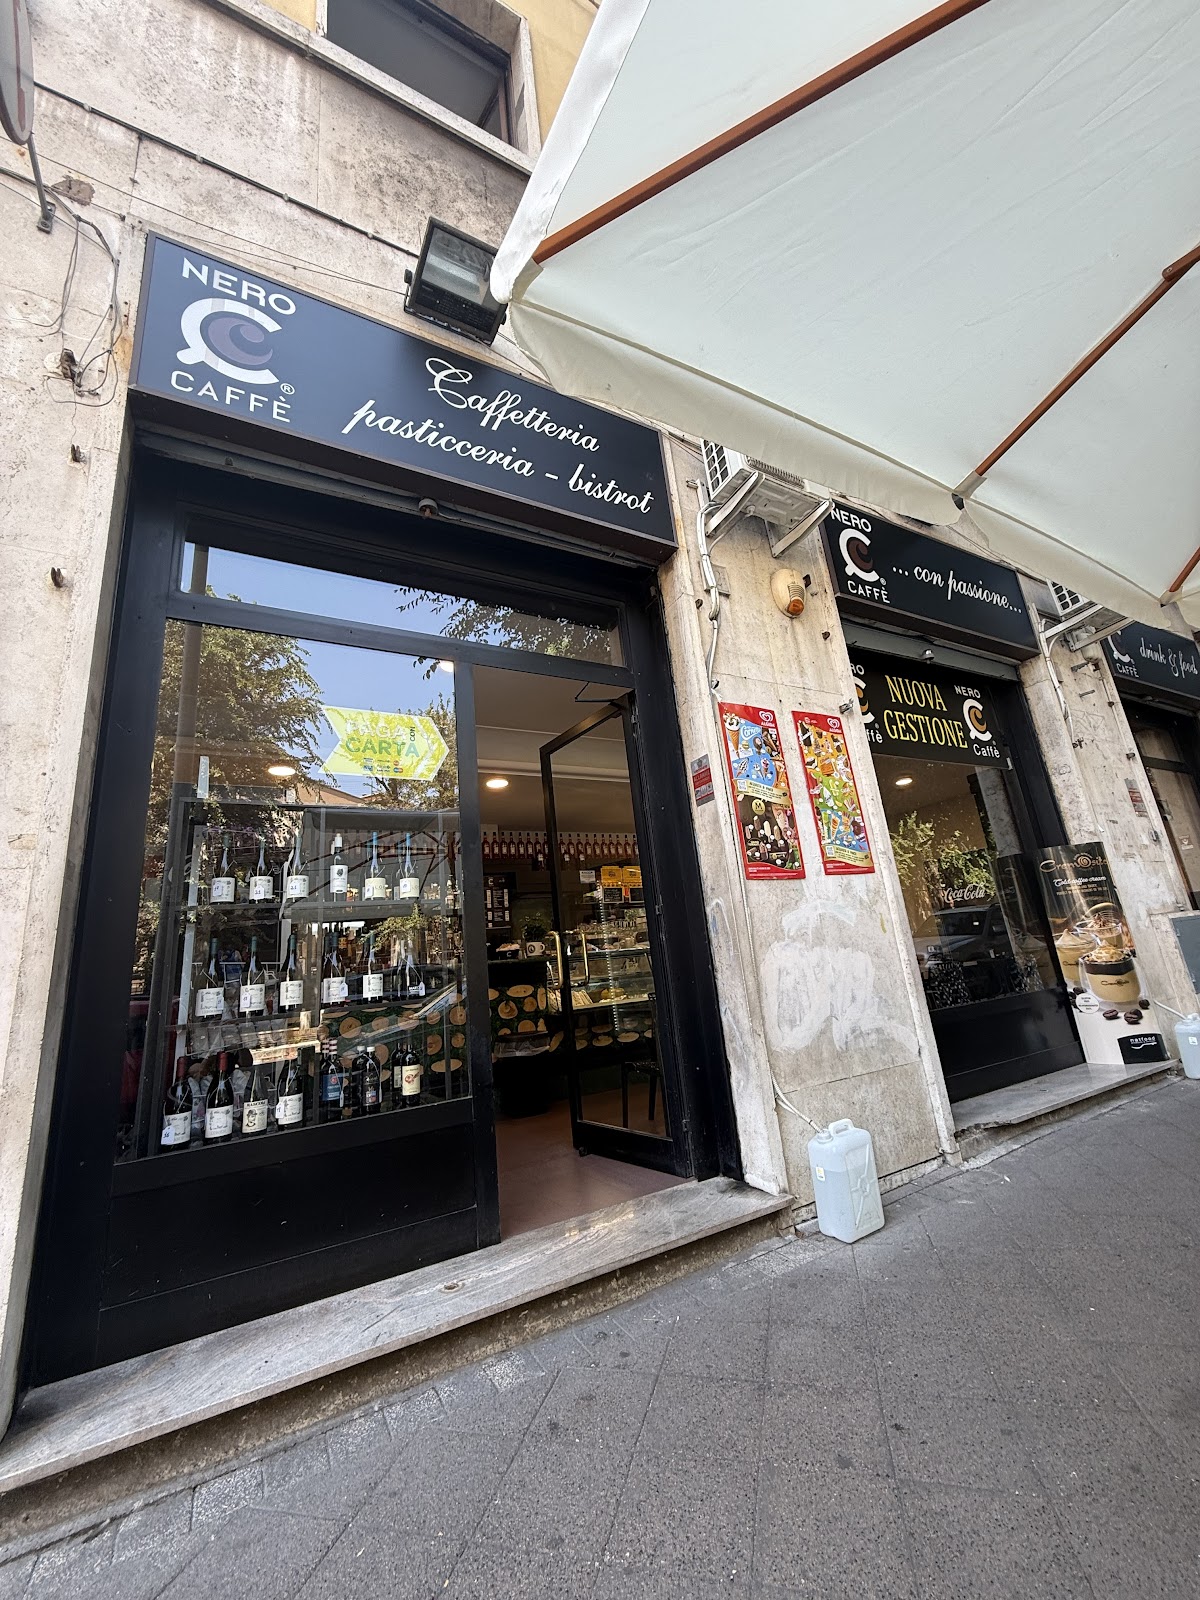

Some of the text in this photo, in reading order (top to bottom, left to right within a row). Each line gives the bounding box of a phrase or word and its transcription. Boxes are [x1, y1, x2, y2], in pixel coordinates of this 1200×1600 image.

[181, 257, 296, 315] NERO
[170, 370, 291, 423] CAFFÈ
[425, 357, 600, 452] Caffetteria
[341, 399, 535, 478] pasticceria
[568, 463, 655, 514] bistrot
[831, 507, 872, 533] NERO
[913, 565, 945, 588] con
[847, 580, 891, 604] CAFFÈ
[1139, 637, 1167, 665] drink
[884, 674, 948, 712] NUOVA
[954, 685, 981, 699] NERO
[883, 709, 968, 749] GESTIONE
[345, 737, 420, 758] CARTA
[973, 743, 1000, 759] Caffè
